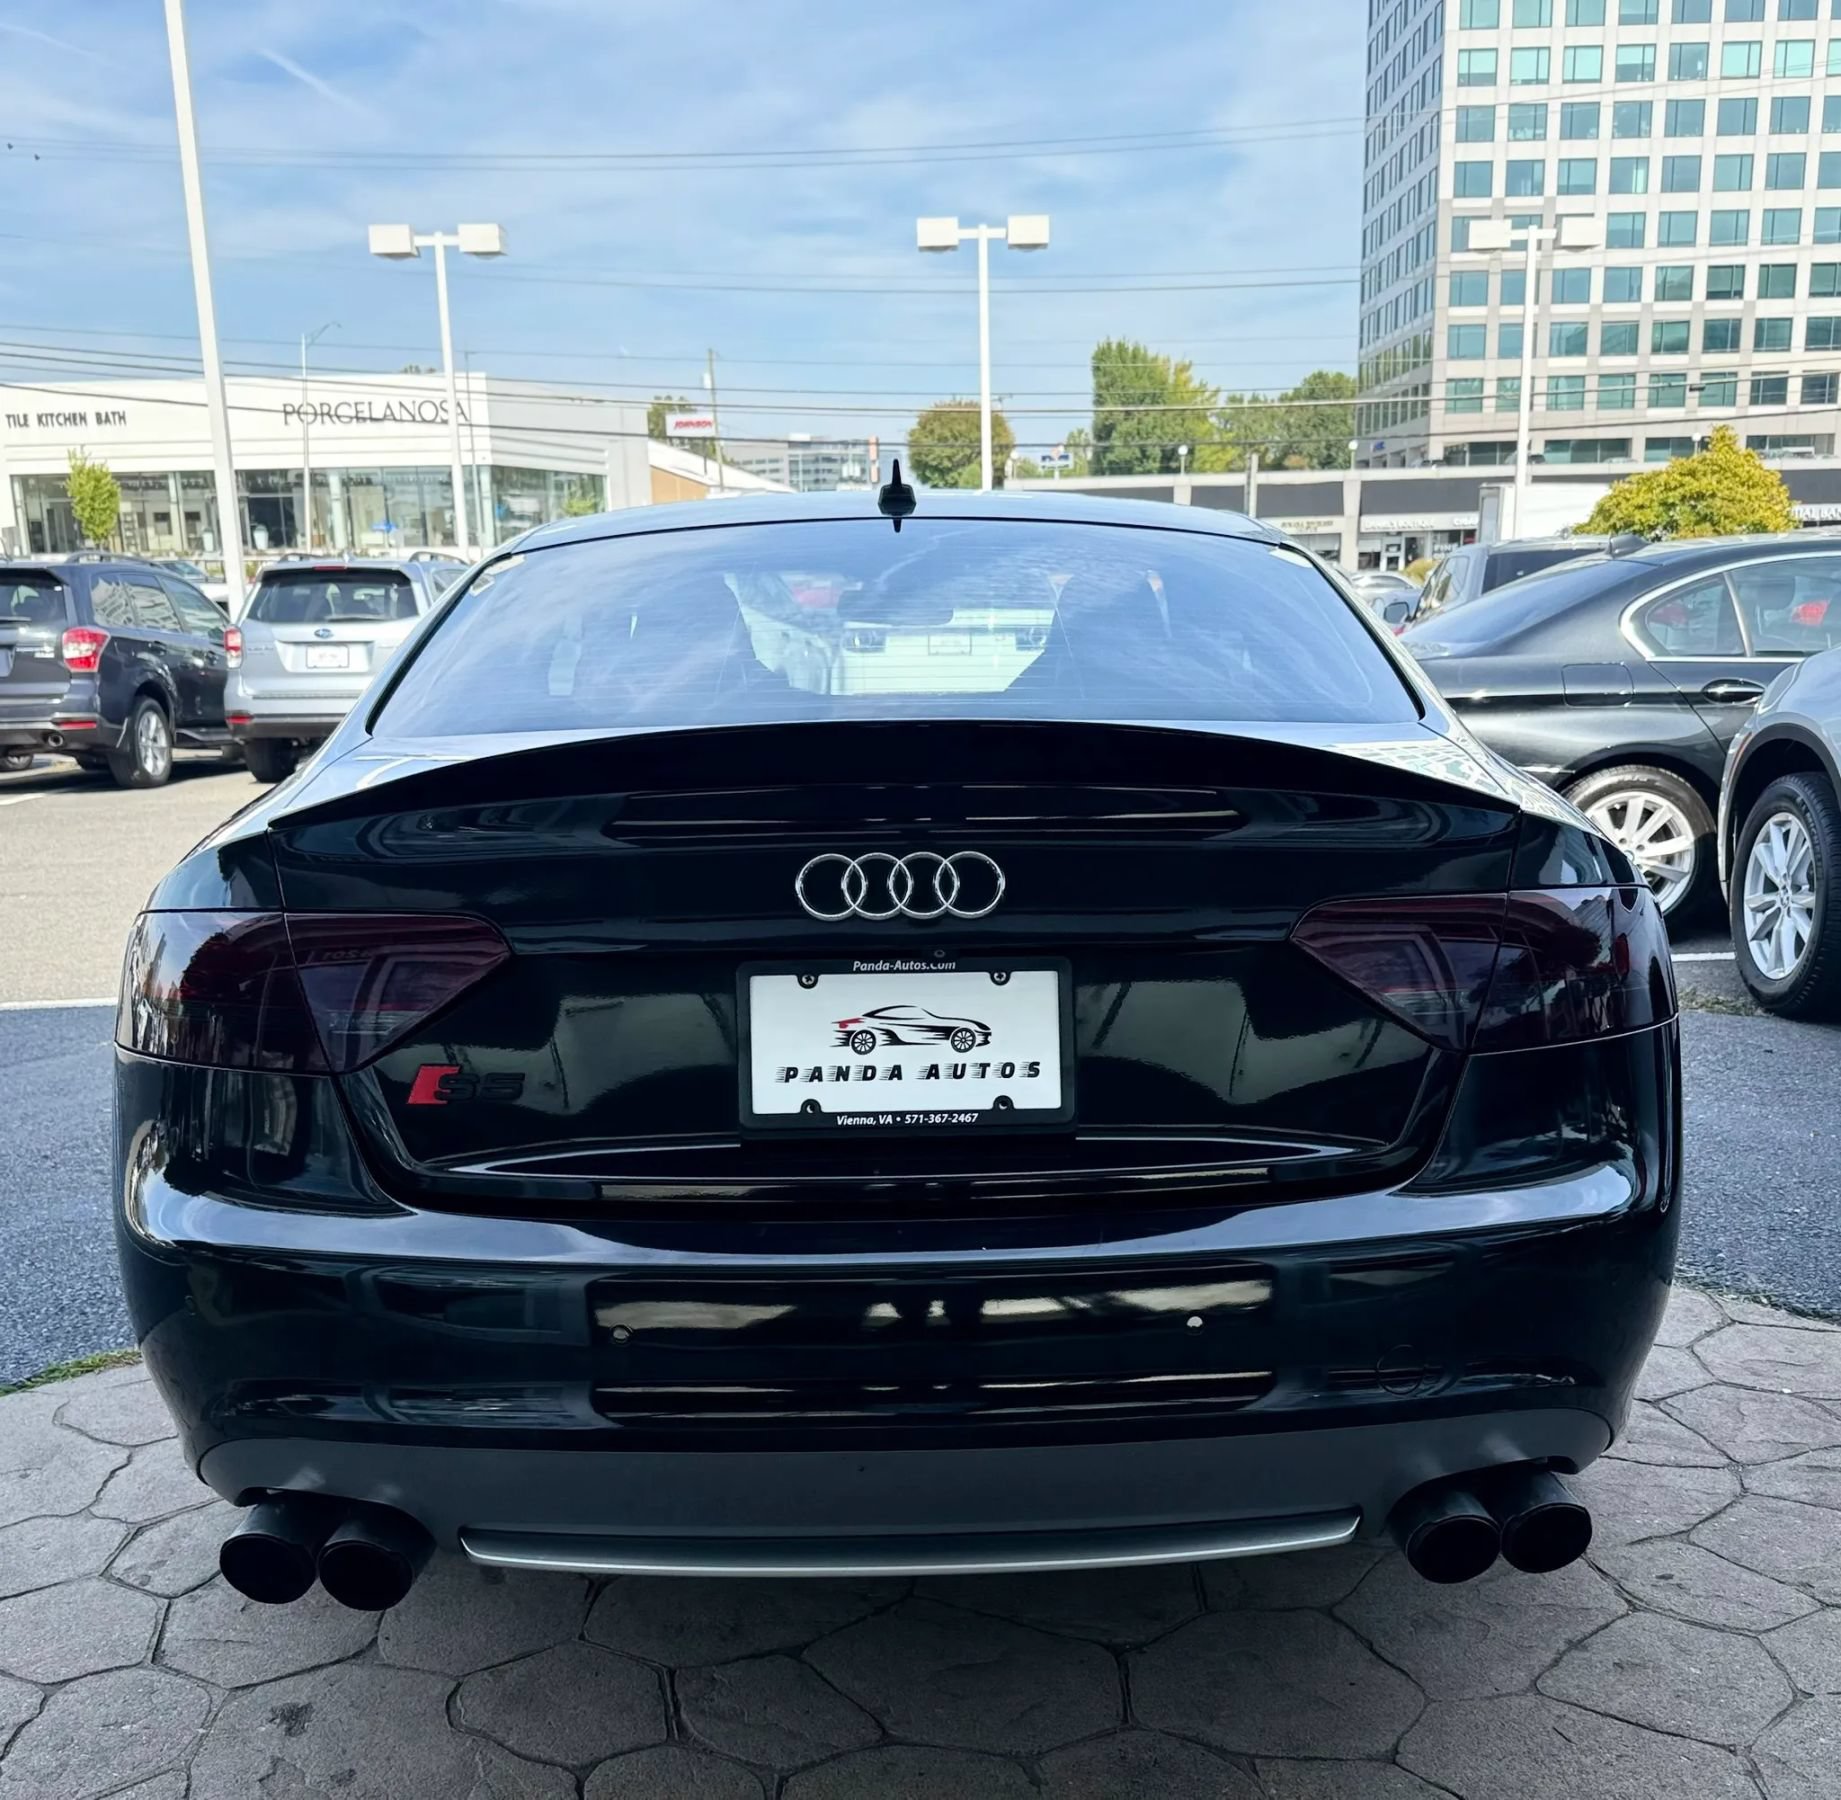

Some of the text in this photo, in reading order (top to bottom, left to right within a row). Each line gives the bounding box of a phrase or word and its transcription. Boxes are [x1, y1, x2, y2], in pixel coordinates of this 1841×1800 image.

[5, 410, 127, 429] TILE KITCHEN BATH
[282, 399, 470, 426] PORCELANOSA
[776, 1061, 1041, 1083] PANDA AUTOS
[433, 1072, 525, 1102] S5
[836, 1112, 979, 1126] Vienna, VA 571-367-2467
